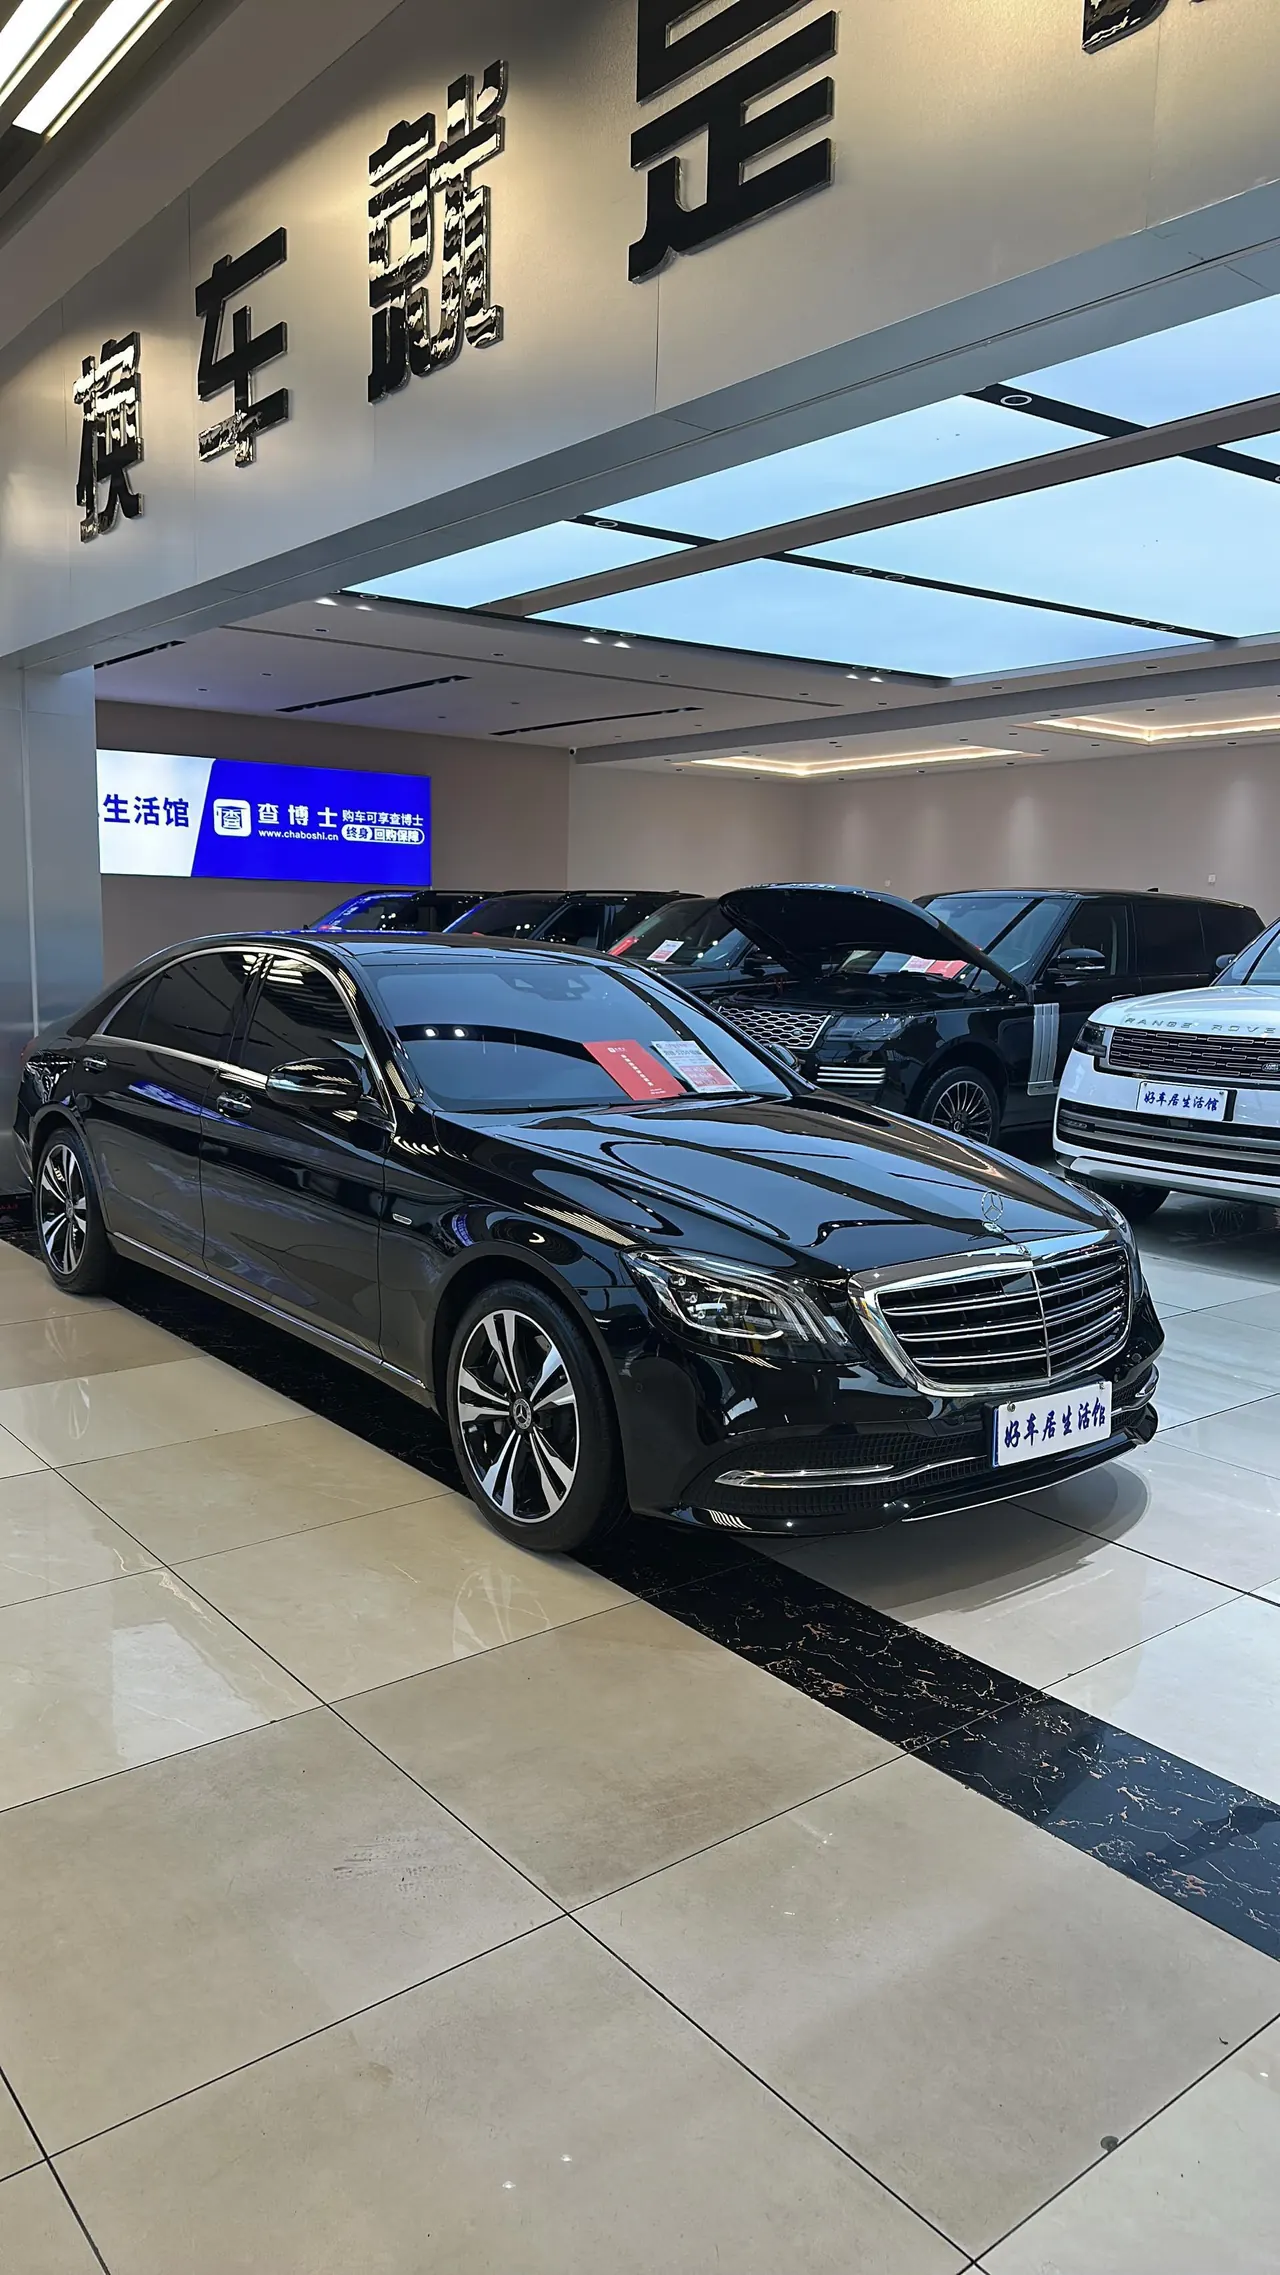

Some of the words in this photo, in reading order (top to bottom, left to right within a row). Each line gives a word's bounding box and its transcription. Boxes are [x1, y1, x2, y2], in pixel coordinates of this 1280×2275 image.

[73, 0, 1206, 543] 换车就是
[103, 794, 190, 828] 生活馆
[257, 803, 338, 827] 查博士
[342, 809, 424, 827] 购车可享查博士
[258, 828, 339, 841] www.chaboshi.cn
[1125, 1018, 1192, 1028] RANGE
[1004, 1397, 1106, 1448] 好车居生活馆
